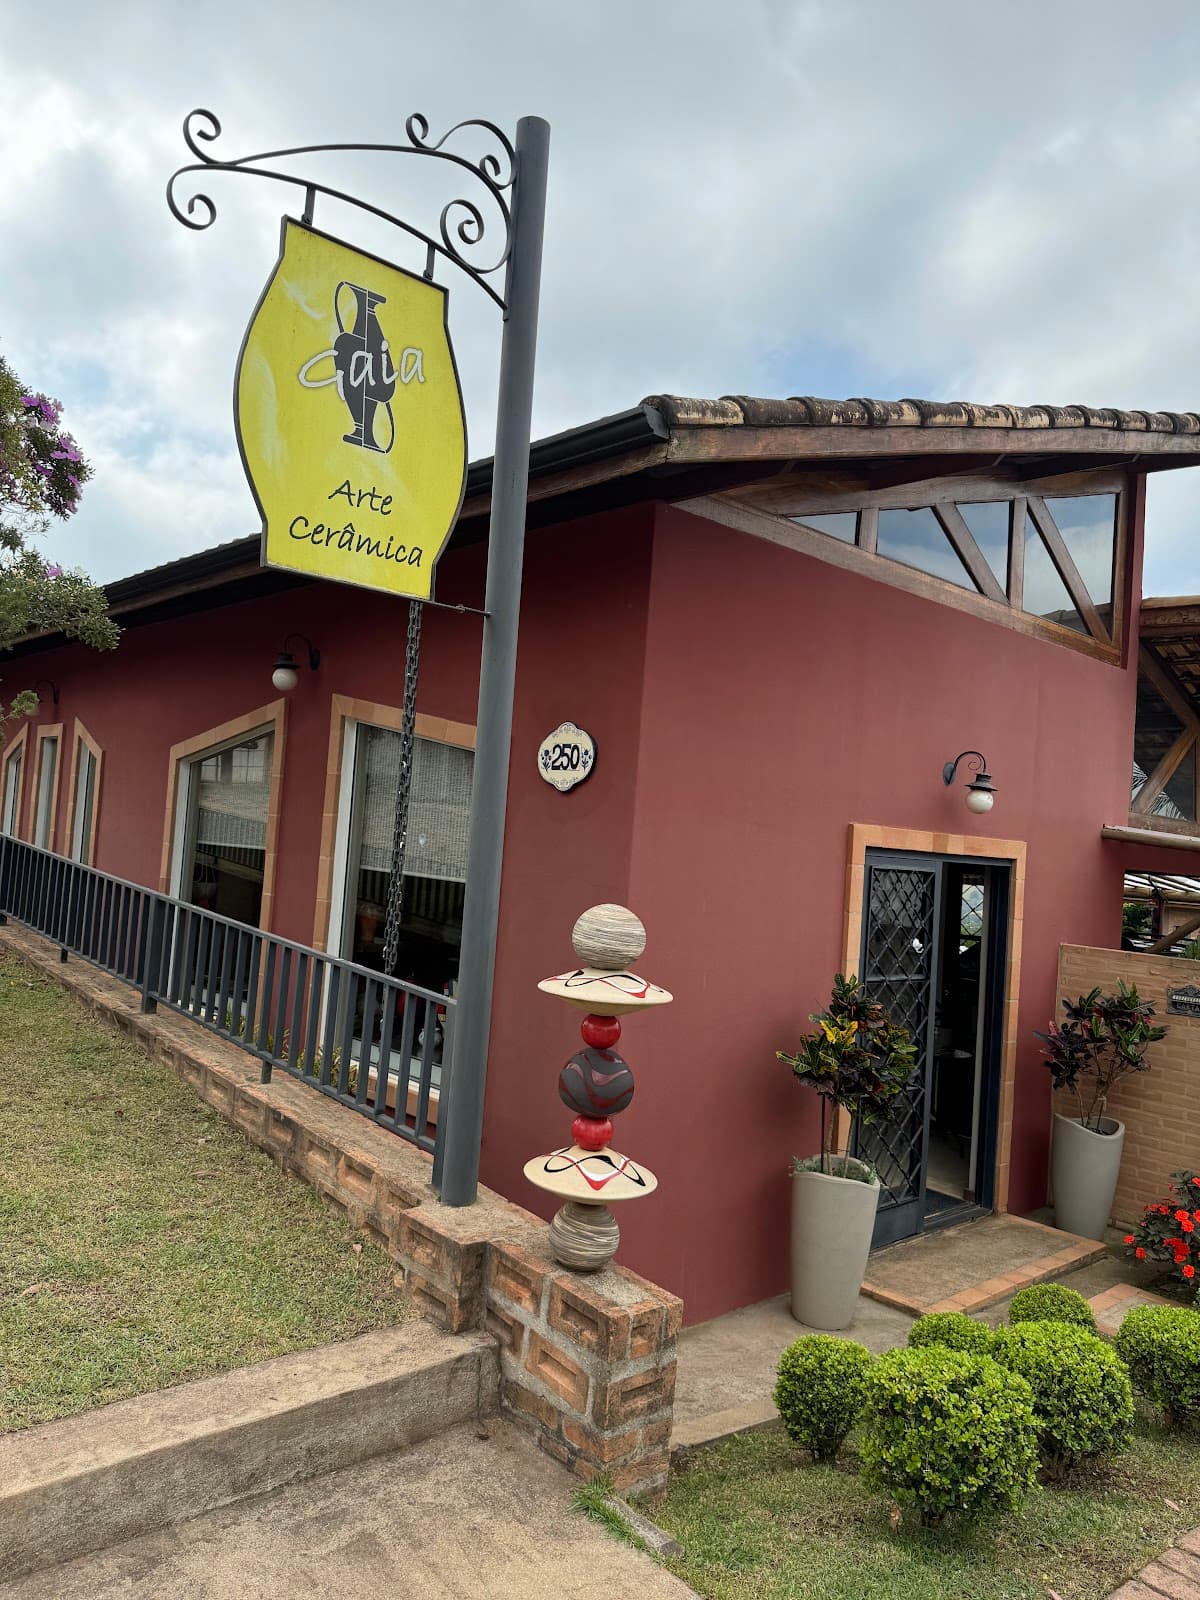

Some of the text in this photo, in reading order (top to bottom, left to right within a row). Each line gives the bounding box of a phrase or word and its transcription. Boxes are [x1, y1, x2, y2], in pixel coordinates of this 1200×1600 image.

[298, 339, 426, 401] Gaia
[328, 479, 393, 515] Arte
[289, 515, 423, 567] Cerâmica
[551, 743, 580, 771] 250
